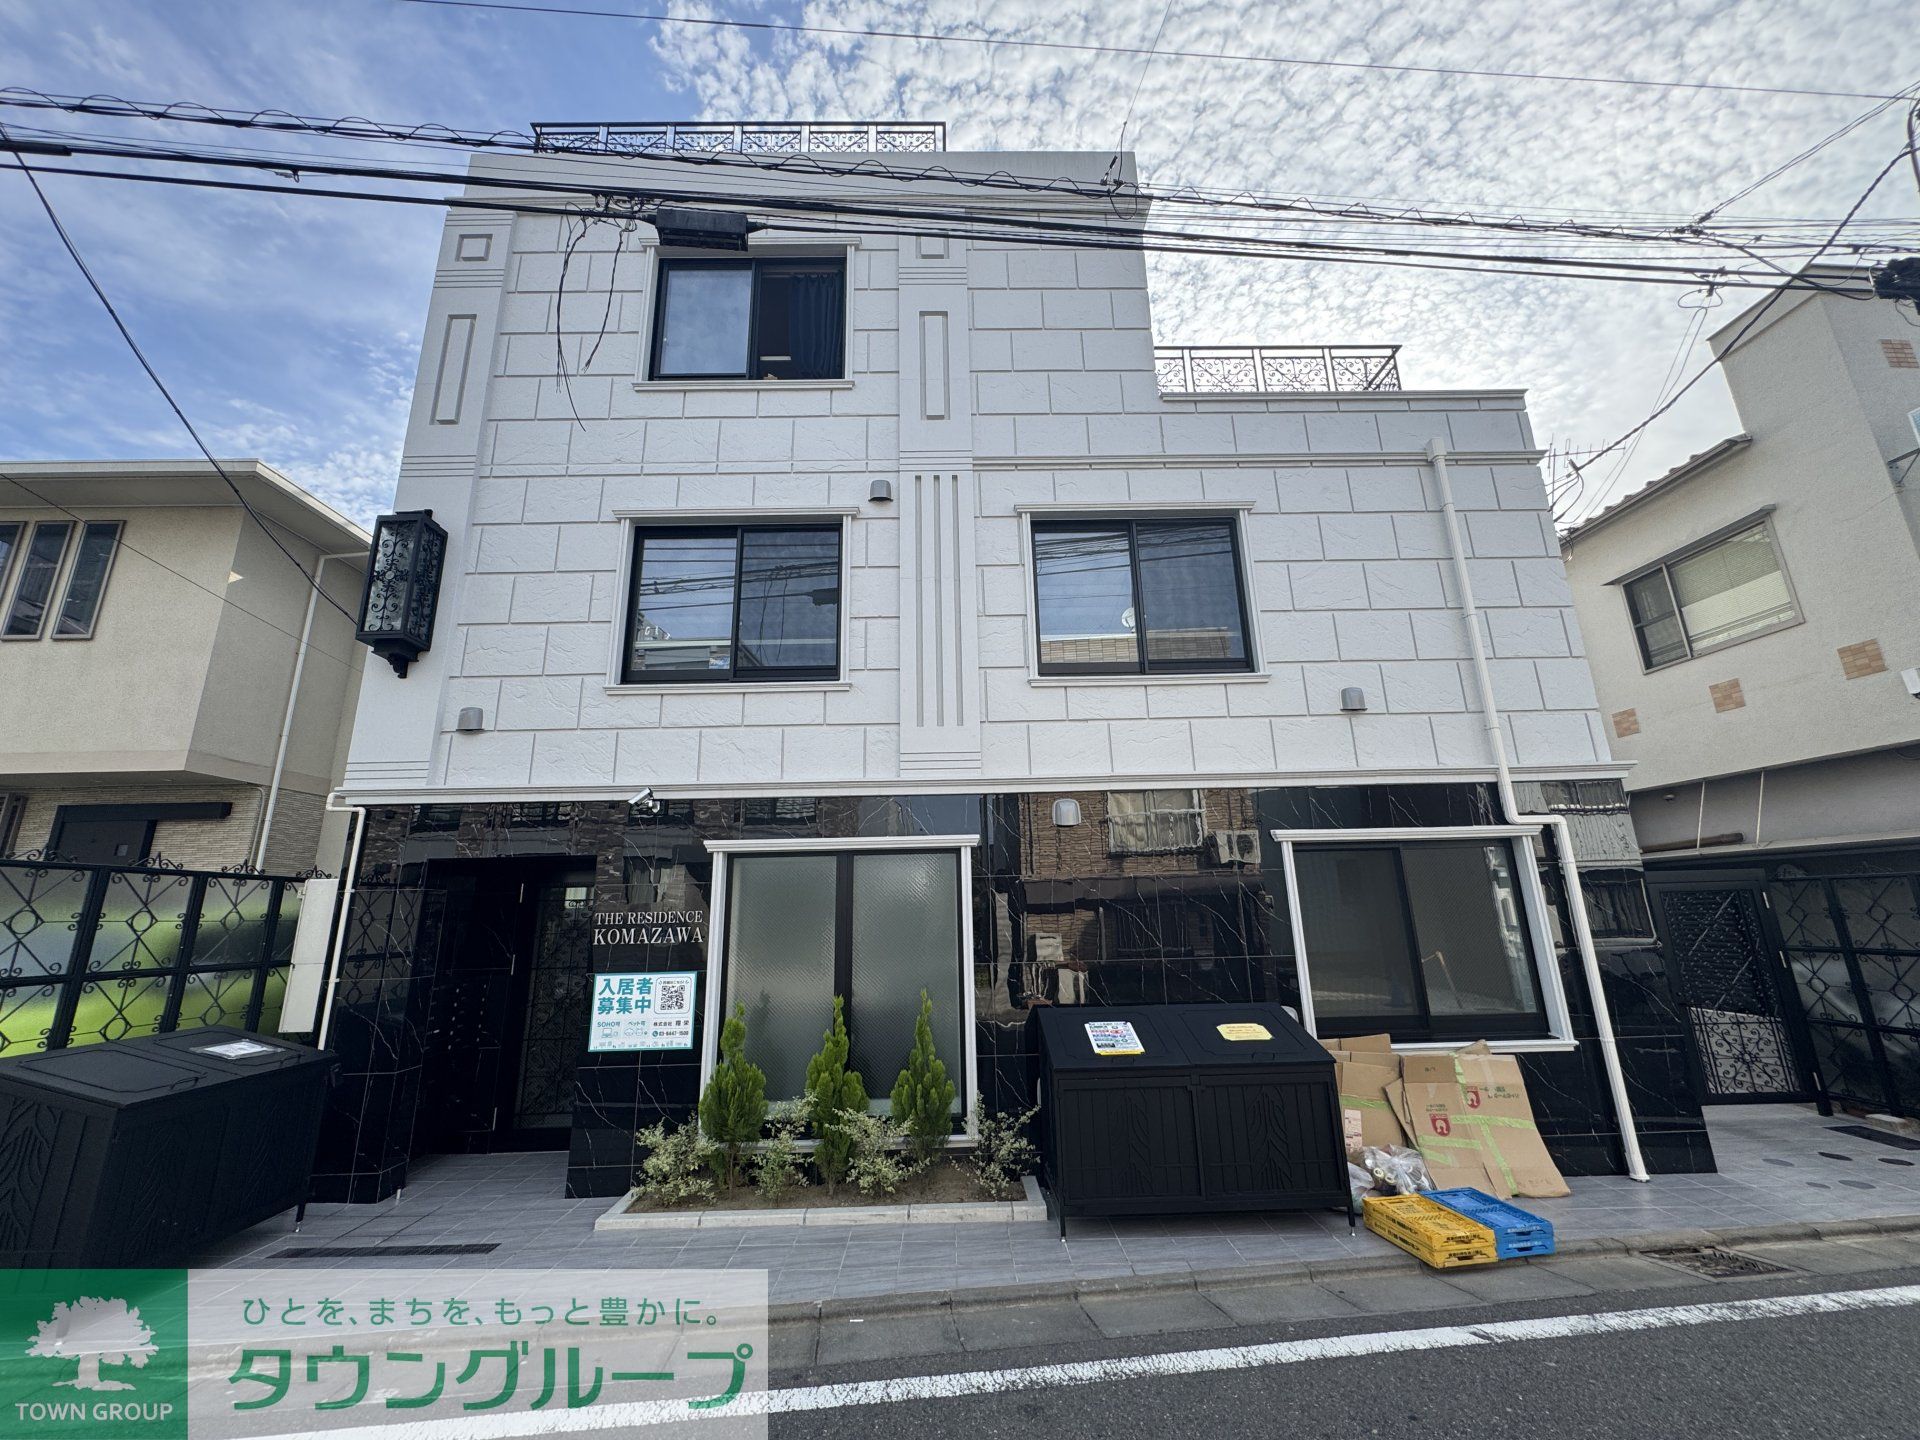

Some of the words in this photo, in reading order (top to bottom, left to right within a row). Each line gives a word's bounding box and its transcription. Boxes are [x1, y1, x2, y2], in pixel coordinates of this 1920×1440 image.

[595, 912, 624, 925] THE
[627, 910, 703, 925] RESIDENCE
[593, 926, 704, 945] KOMAZAWA
[598, 977, 654, 996] 入居者
[597, 996, 651, 1015] 募集中
